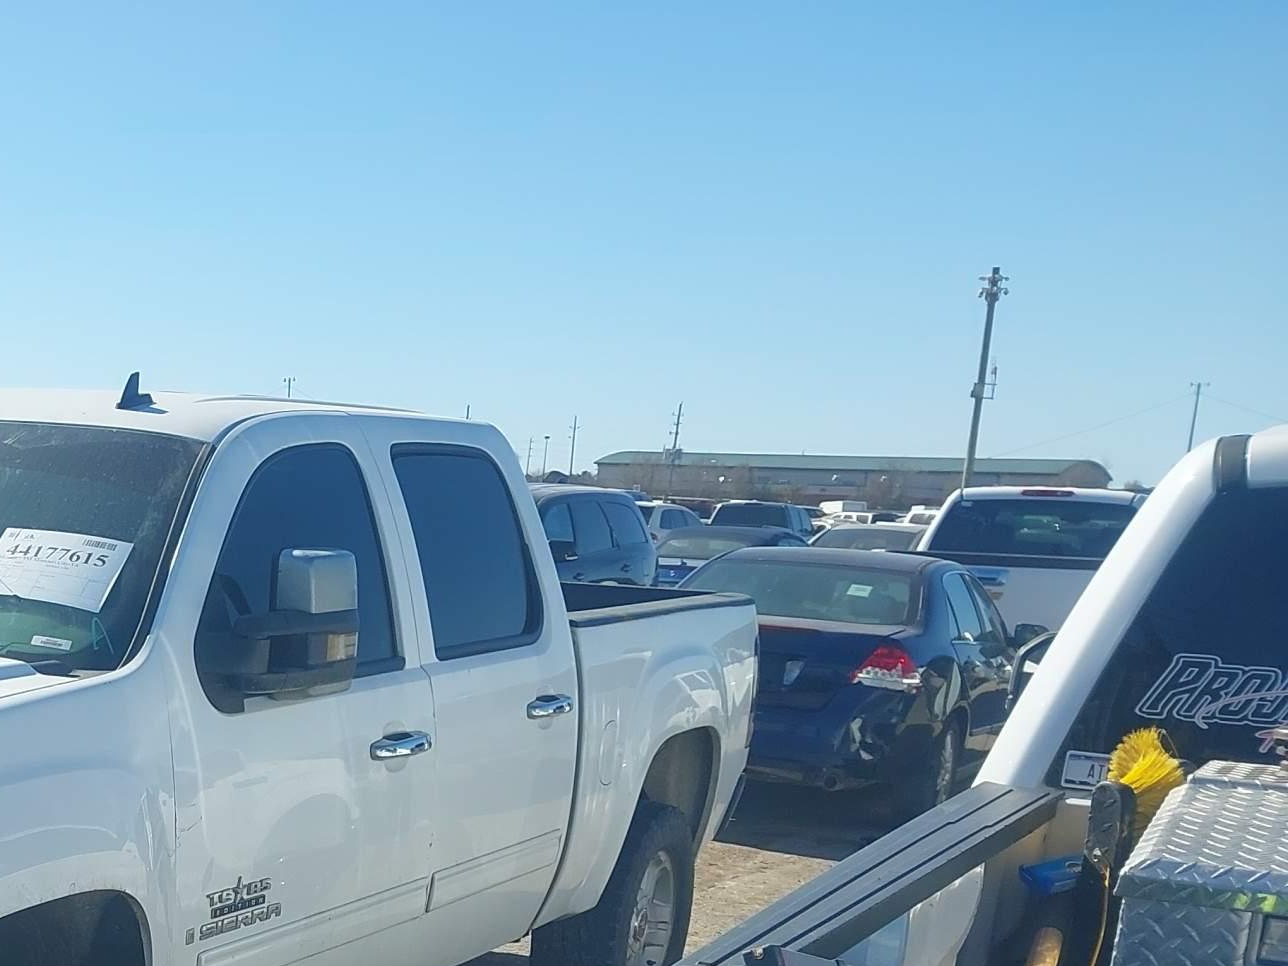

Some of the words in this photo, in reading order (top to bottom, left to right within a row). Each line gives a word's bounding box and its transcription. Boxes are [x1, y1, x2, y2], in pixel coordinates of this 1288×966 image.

[6, 543, 110, 568] 44177615
[206, 876, 272, 907] TEXAS
[199, 902, 281, 940] SIERRA
